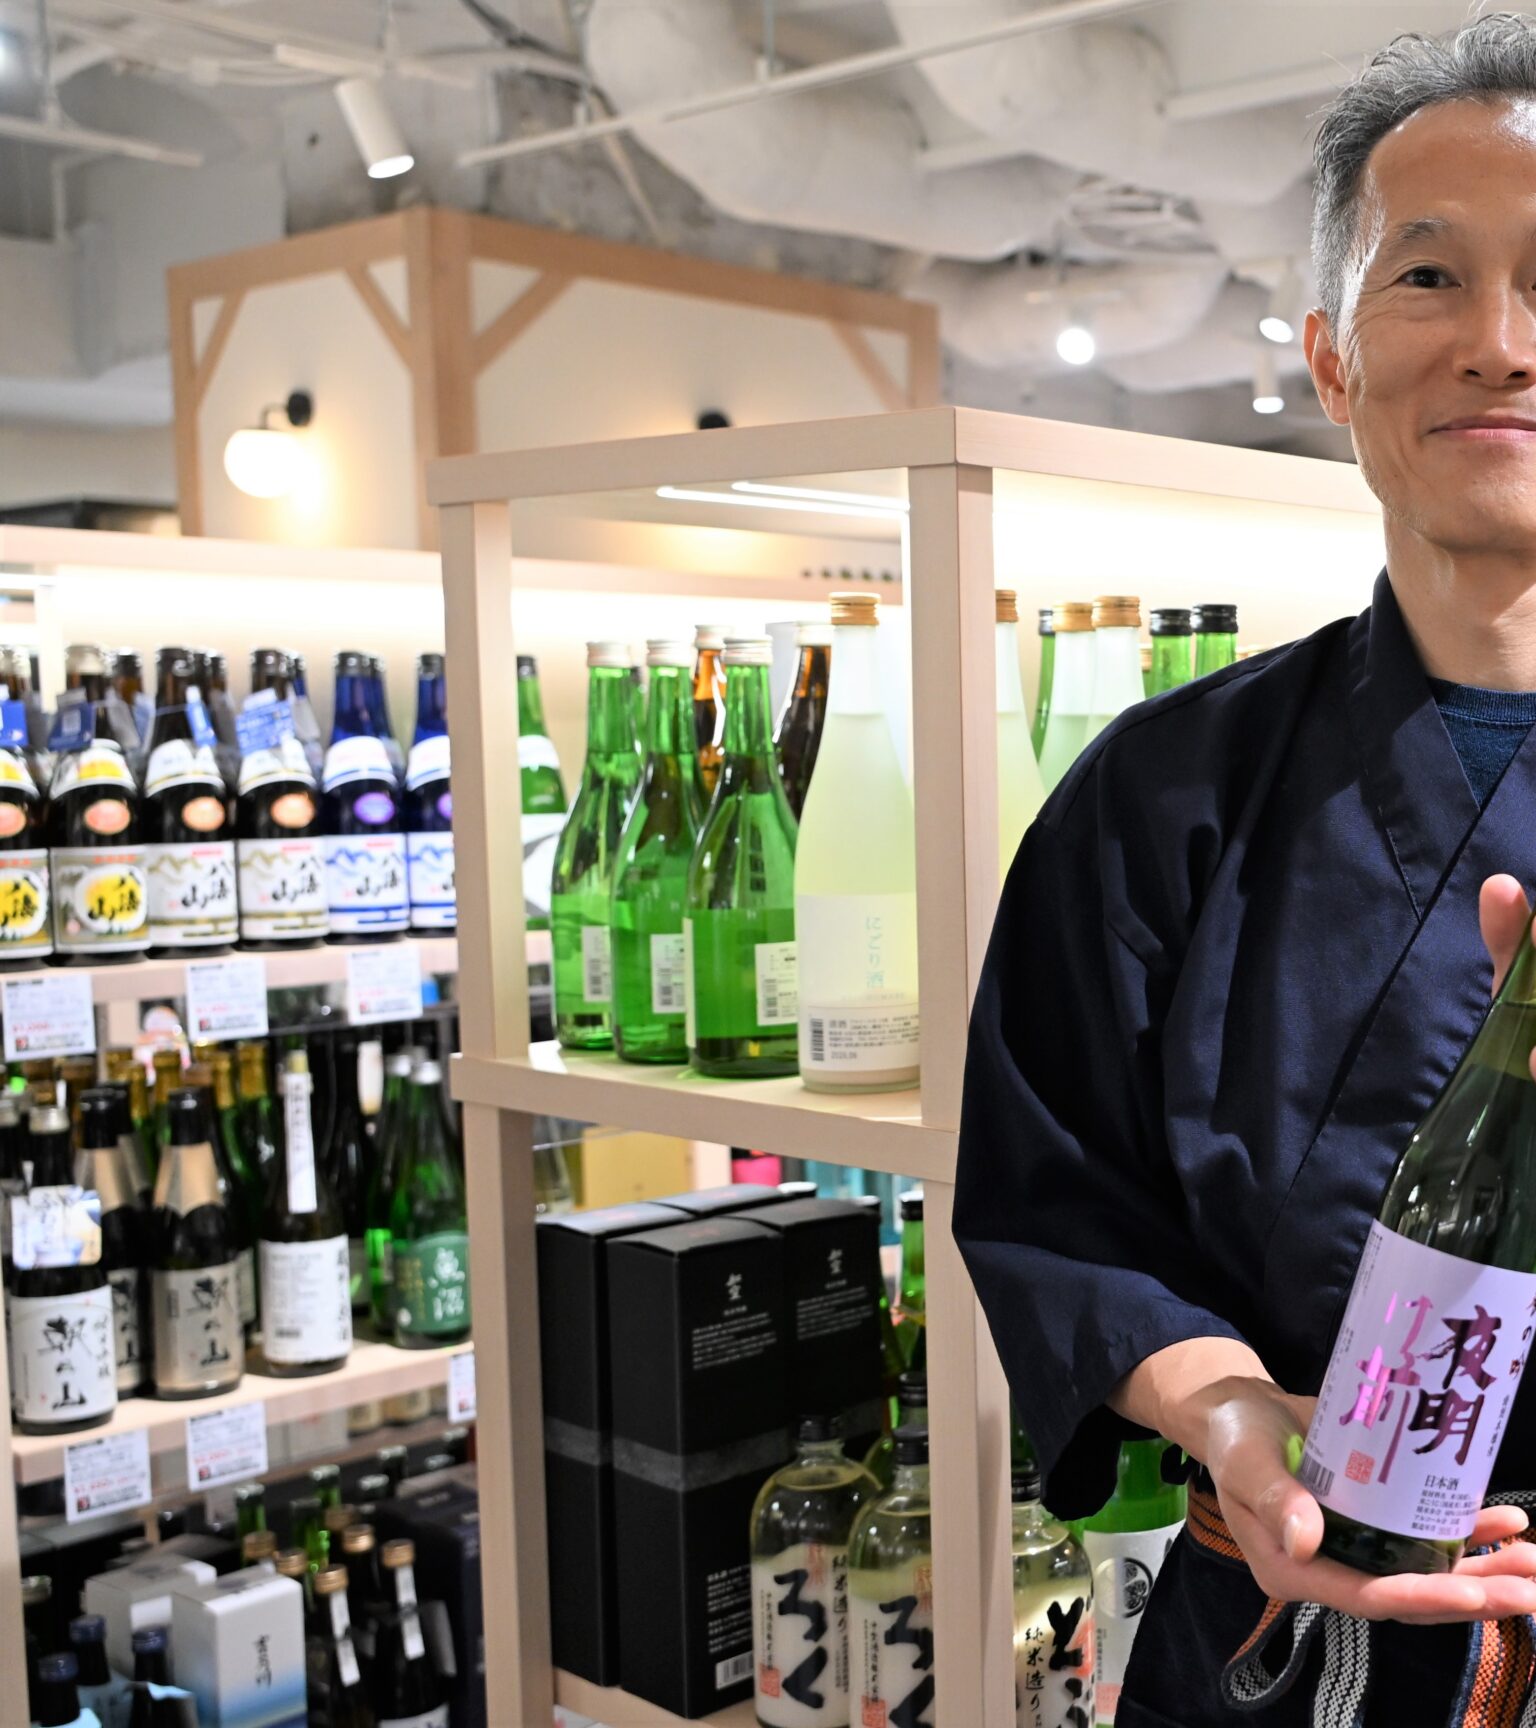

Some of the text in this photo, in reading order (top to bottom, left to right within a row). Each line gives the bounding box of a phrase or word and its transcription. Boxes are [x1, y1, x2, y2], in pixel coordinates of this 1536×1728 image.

[1424, 1474, 1459, 1491] 日本酒
[1023, 1627, 1046, 1713] 純米造り
